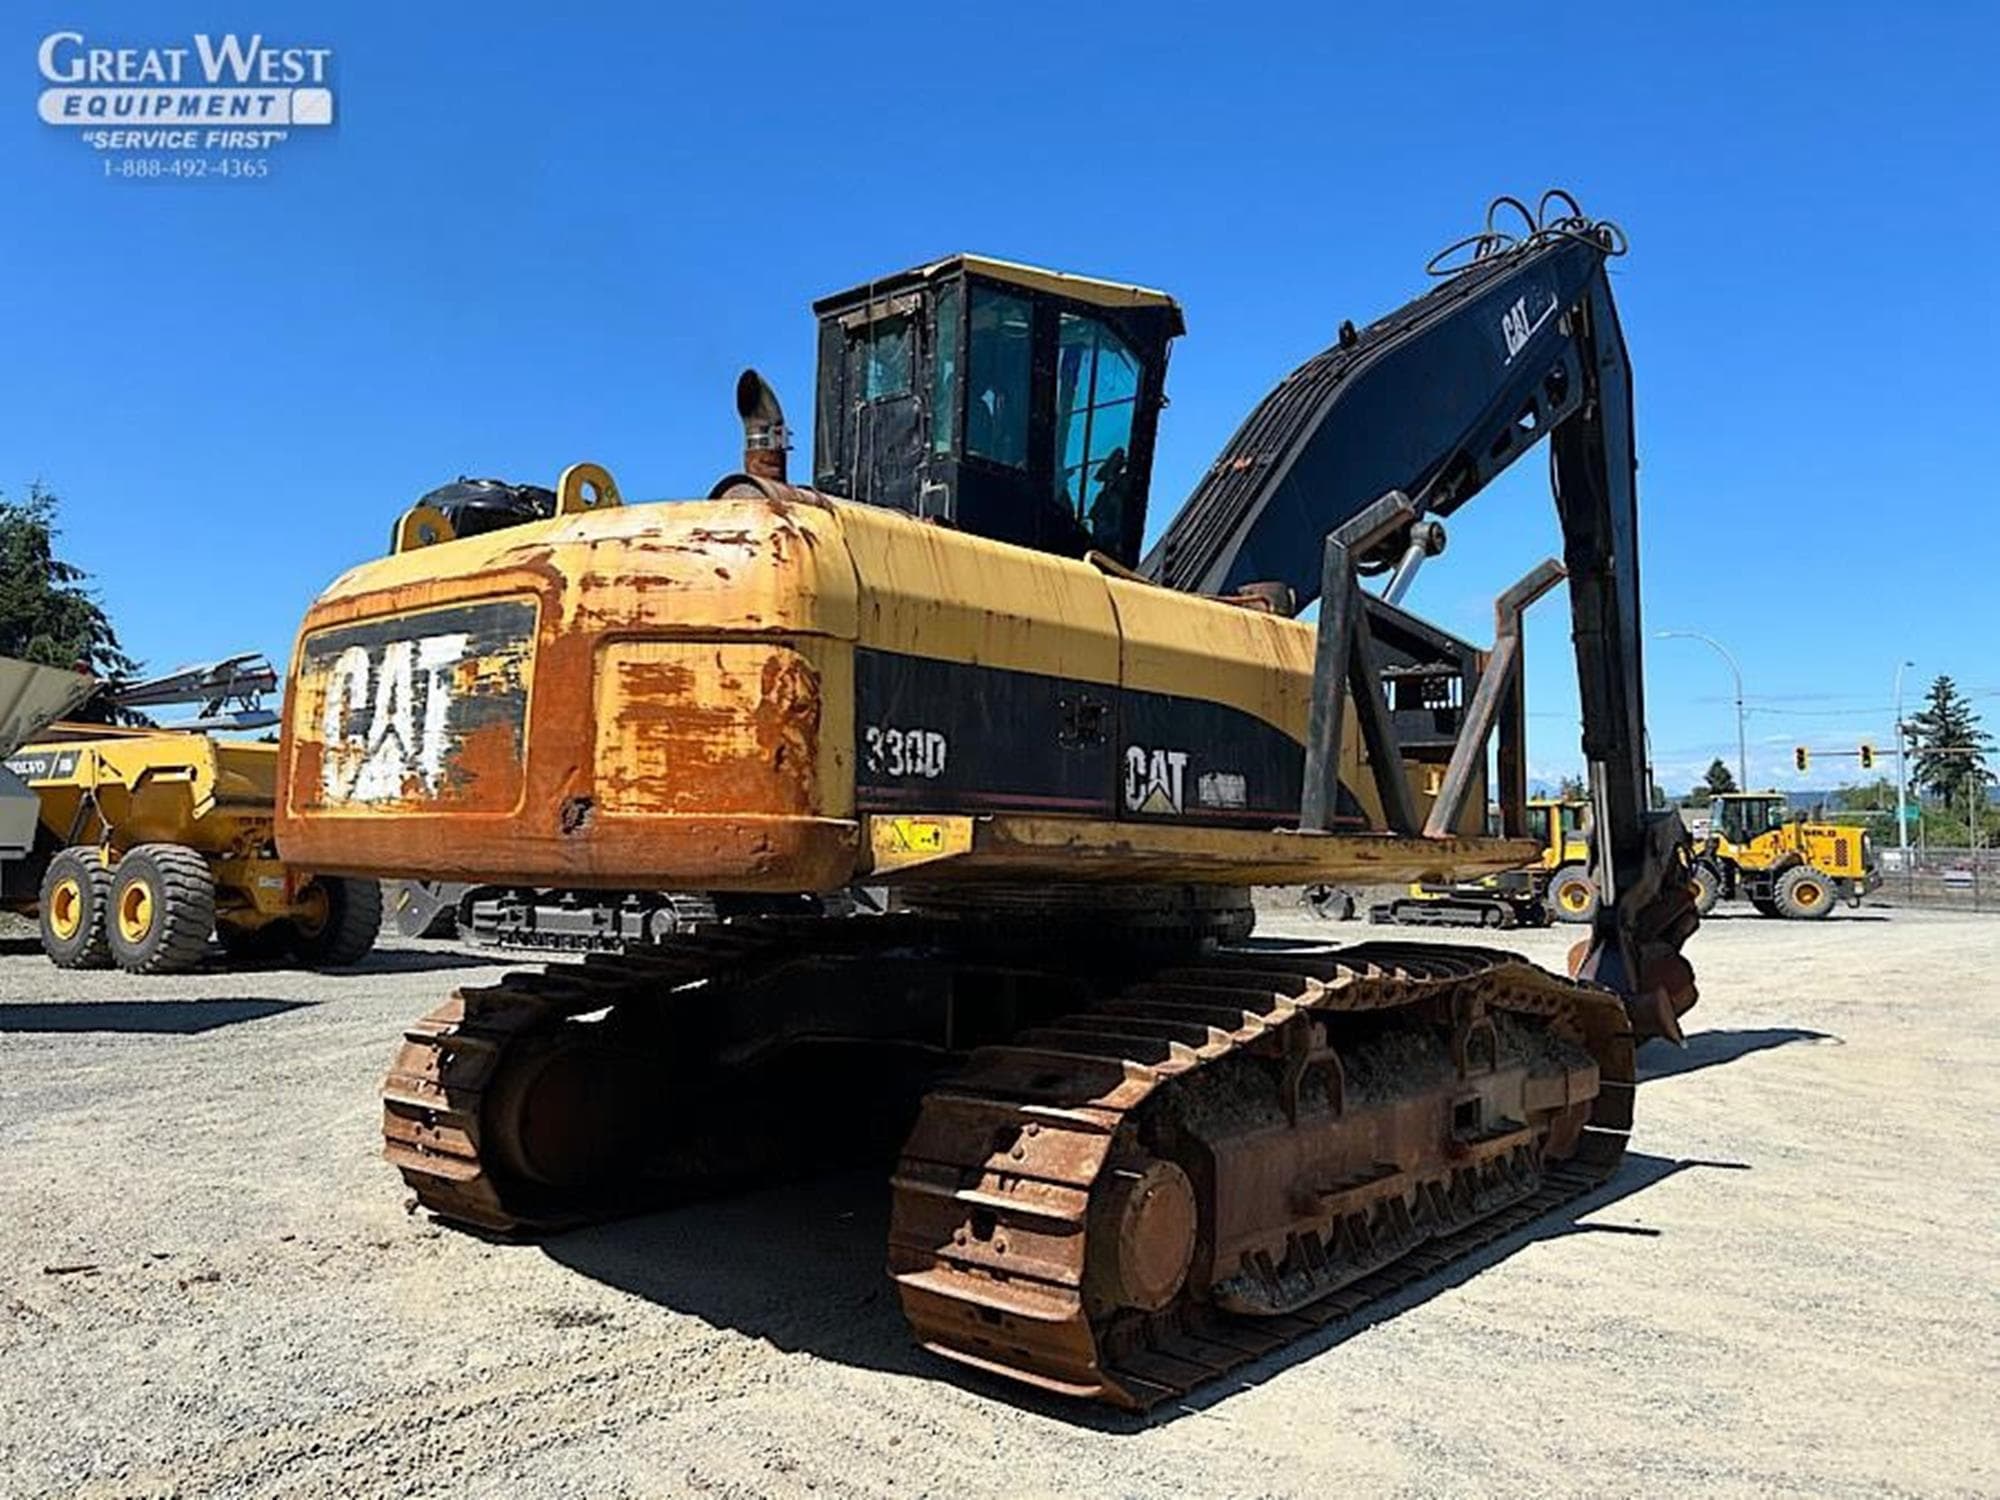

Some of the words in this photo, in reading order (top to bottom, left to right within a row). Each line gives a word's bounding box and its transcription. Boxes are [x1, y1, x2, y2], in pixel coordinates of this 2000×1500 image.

[1502, 297, 1530, 357] CAT
[321, 632, 470, 803] CAT
[1125, 745, 1190, 815] CAT
